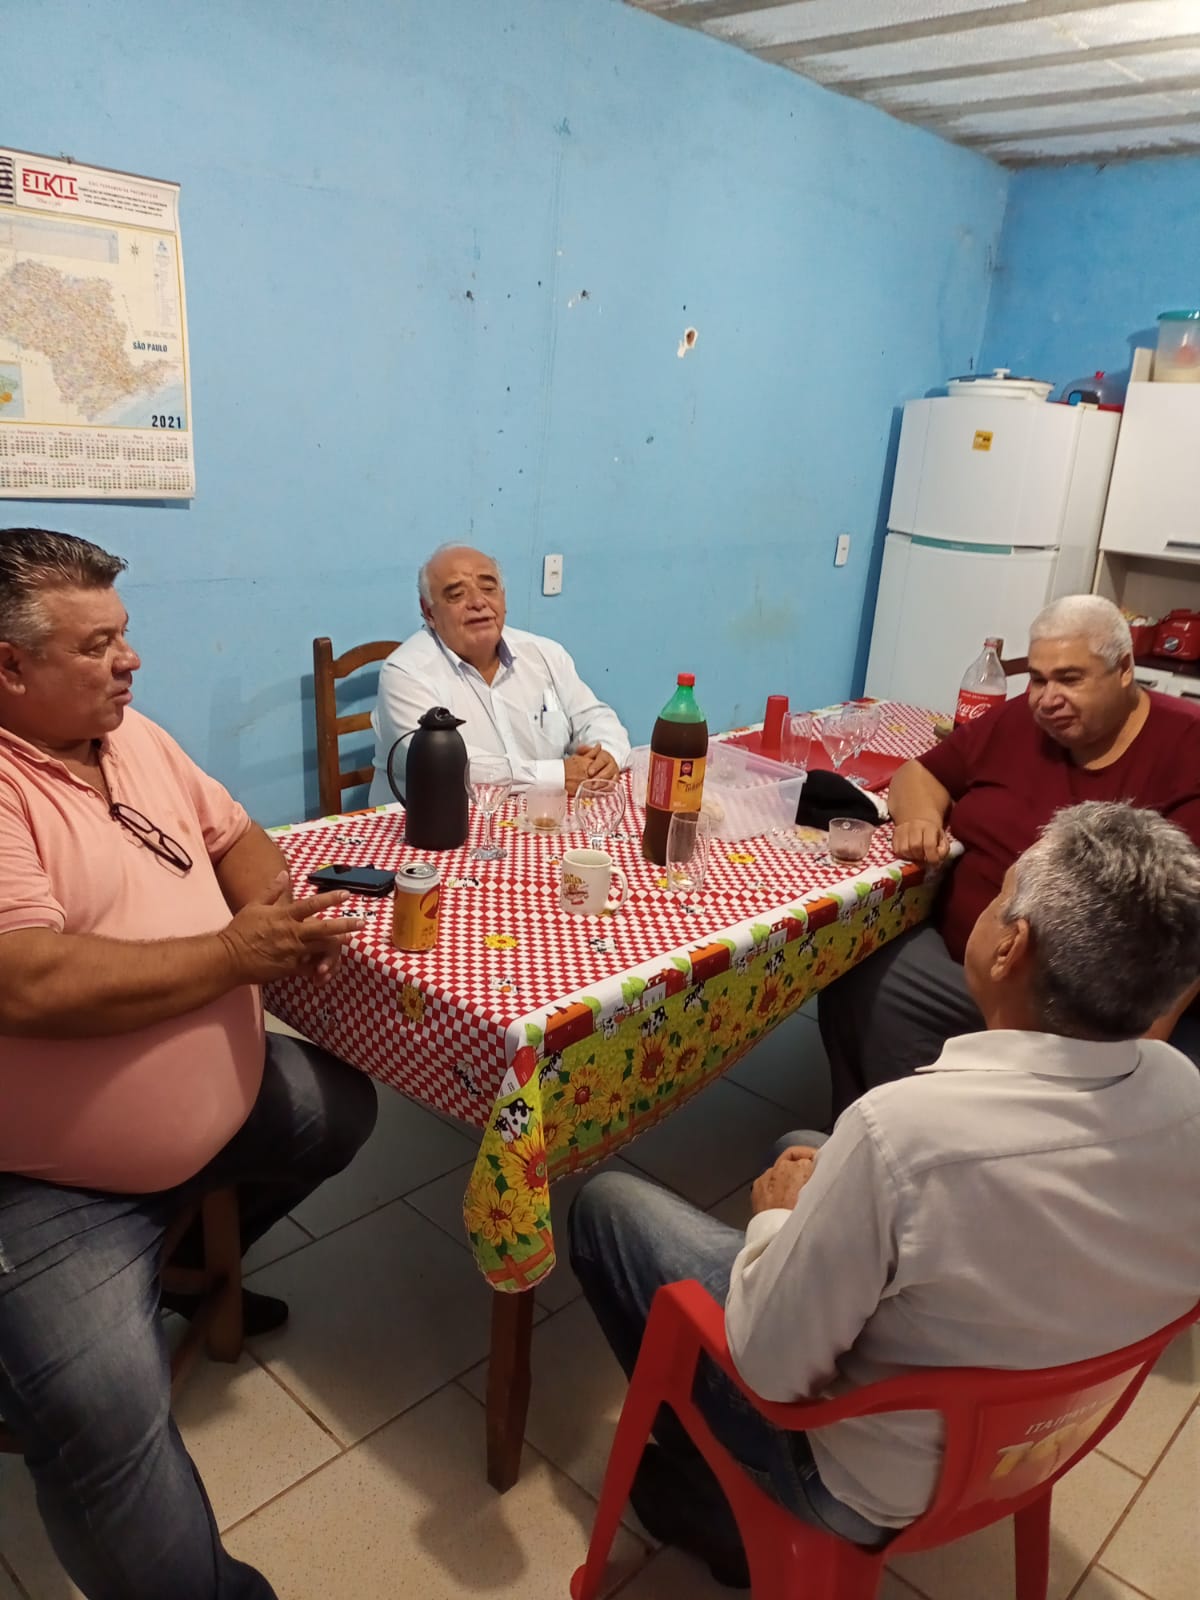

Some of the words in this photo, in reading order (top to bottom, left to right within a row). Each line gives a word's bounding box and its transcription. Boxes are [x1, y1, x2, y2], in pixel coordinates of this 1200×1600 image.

[133, 340, 146, 351] SÃO
[147, 343, 168, 352] PAULO
[151, 414, 182, 430] 2021
